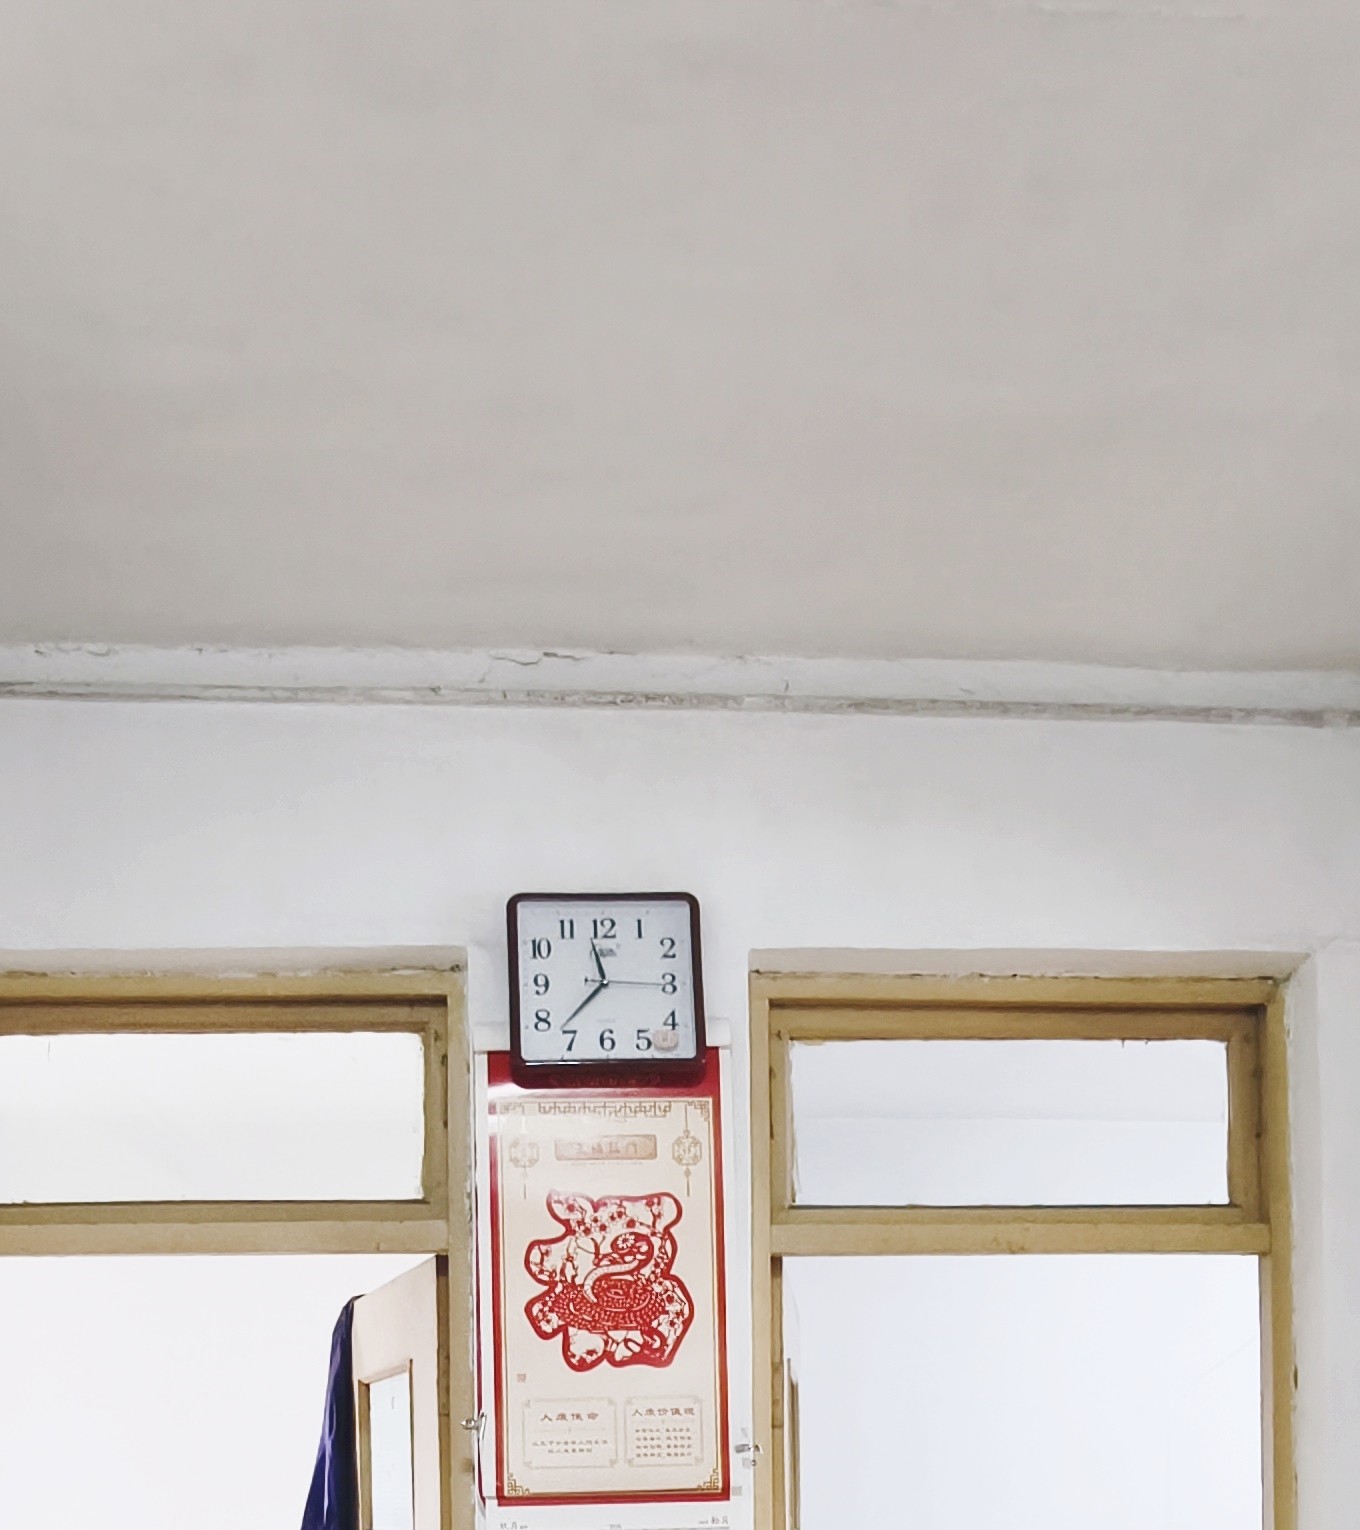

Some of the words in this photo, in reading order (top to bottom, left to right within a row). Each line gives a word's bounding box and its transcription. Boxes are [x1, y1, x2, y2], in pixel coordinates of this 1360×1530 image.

[558, 918, 575, 940] 11
[591, 917, 617, 940] 12
[635, 918, 643, 940] 1
[530, 938, 552, 960] 10
[659, 937, 677, 959] 2
[533, 973, 550, 996] 9
[661, 972, 678, 995] 3
[533, 1009, 552, 1032] 8
[662, 1009, 679, 1031] 4
[561, 1029, 578, 1052] 7
[599, 1028, 616, 1052] 6
[635, 1029, 653, 1051] 5
